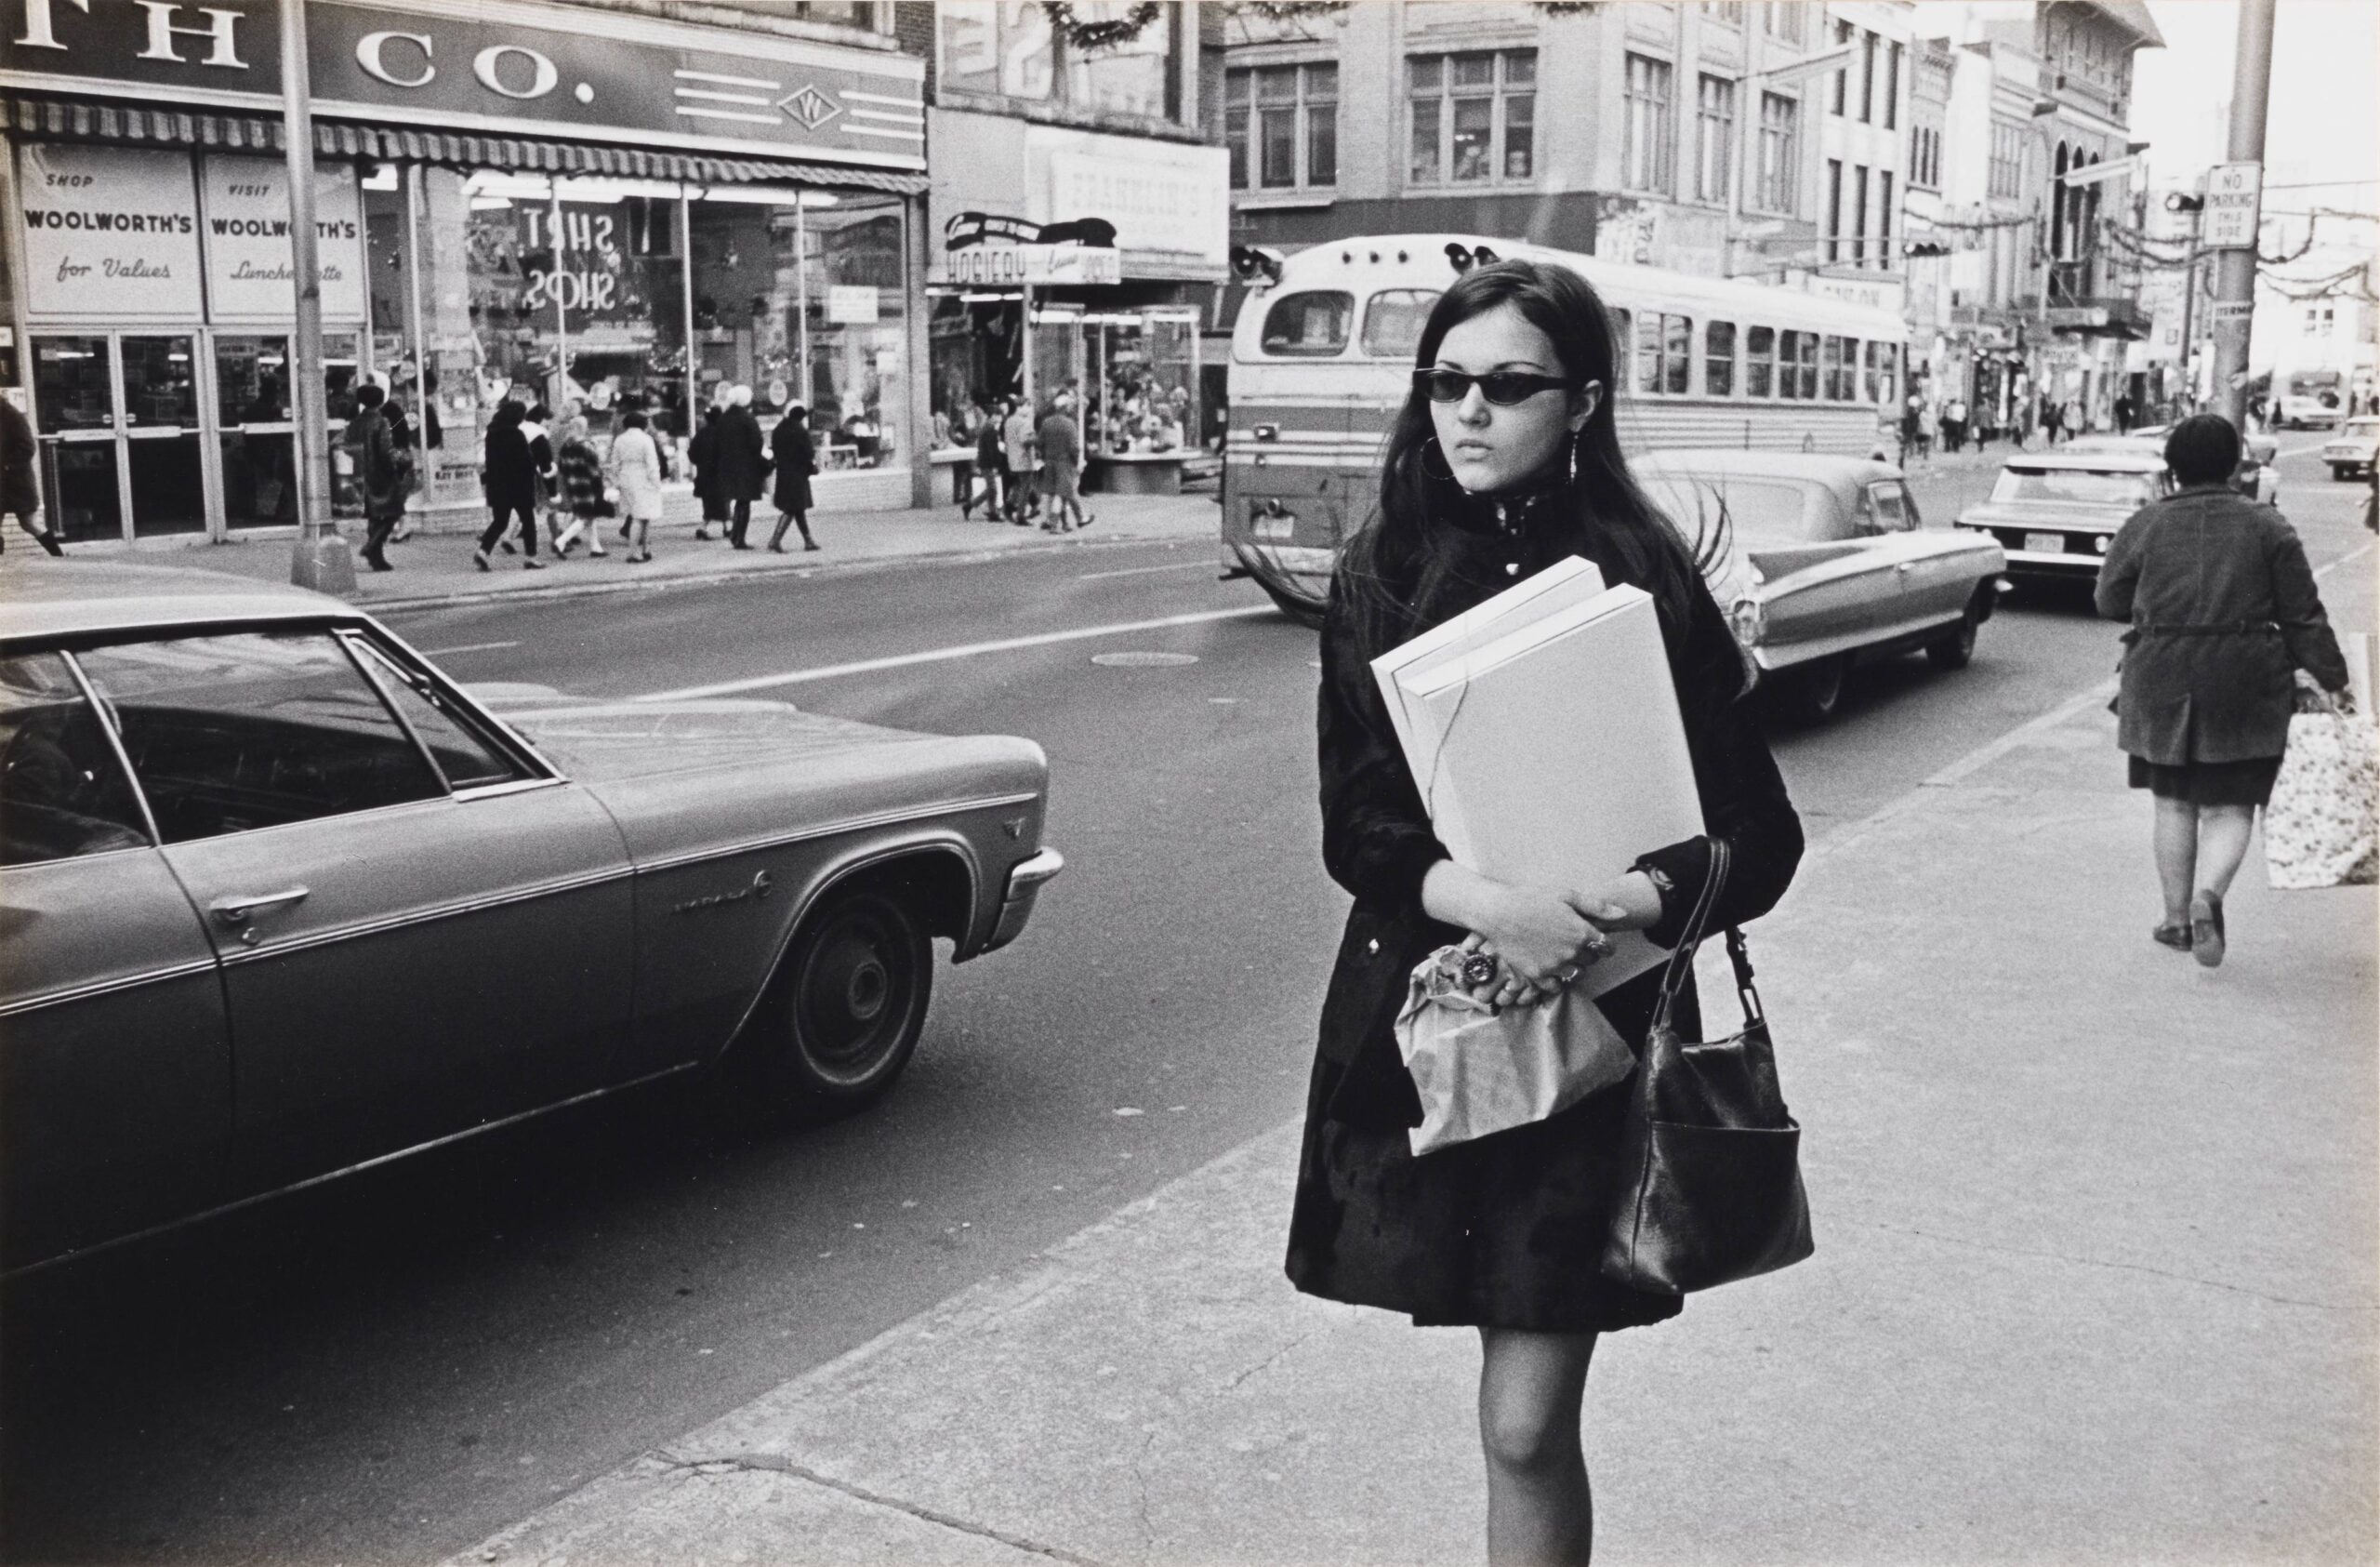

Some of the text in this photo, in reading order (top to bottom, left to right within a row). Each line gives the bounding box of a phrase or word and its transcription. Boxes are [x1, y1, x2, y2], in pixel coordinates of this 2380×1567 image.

[356, 31, 594, 104] CO.
[46, 173, 93, 187] SHOP
[2223, 173, 2242, 190] NO
[229, 184, 271, 196] VISIT
[2210, 193, 2254, 208] PARKING
[25, 209, 192, 233] WOOLWORTH'S
[2218, 211, 2242, 222] THIS
[211, 218, 357, 240] WOOLWTH'S
[2216, 226, 2241, 237] SIDE
[57, 256, 171, 282] for Values
[230, 260, 342, 281] Luncheette
